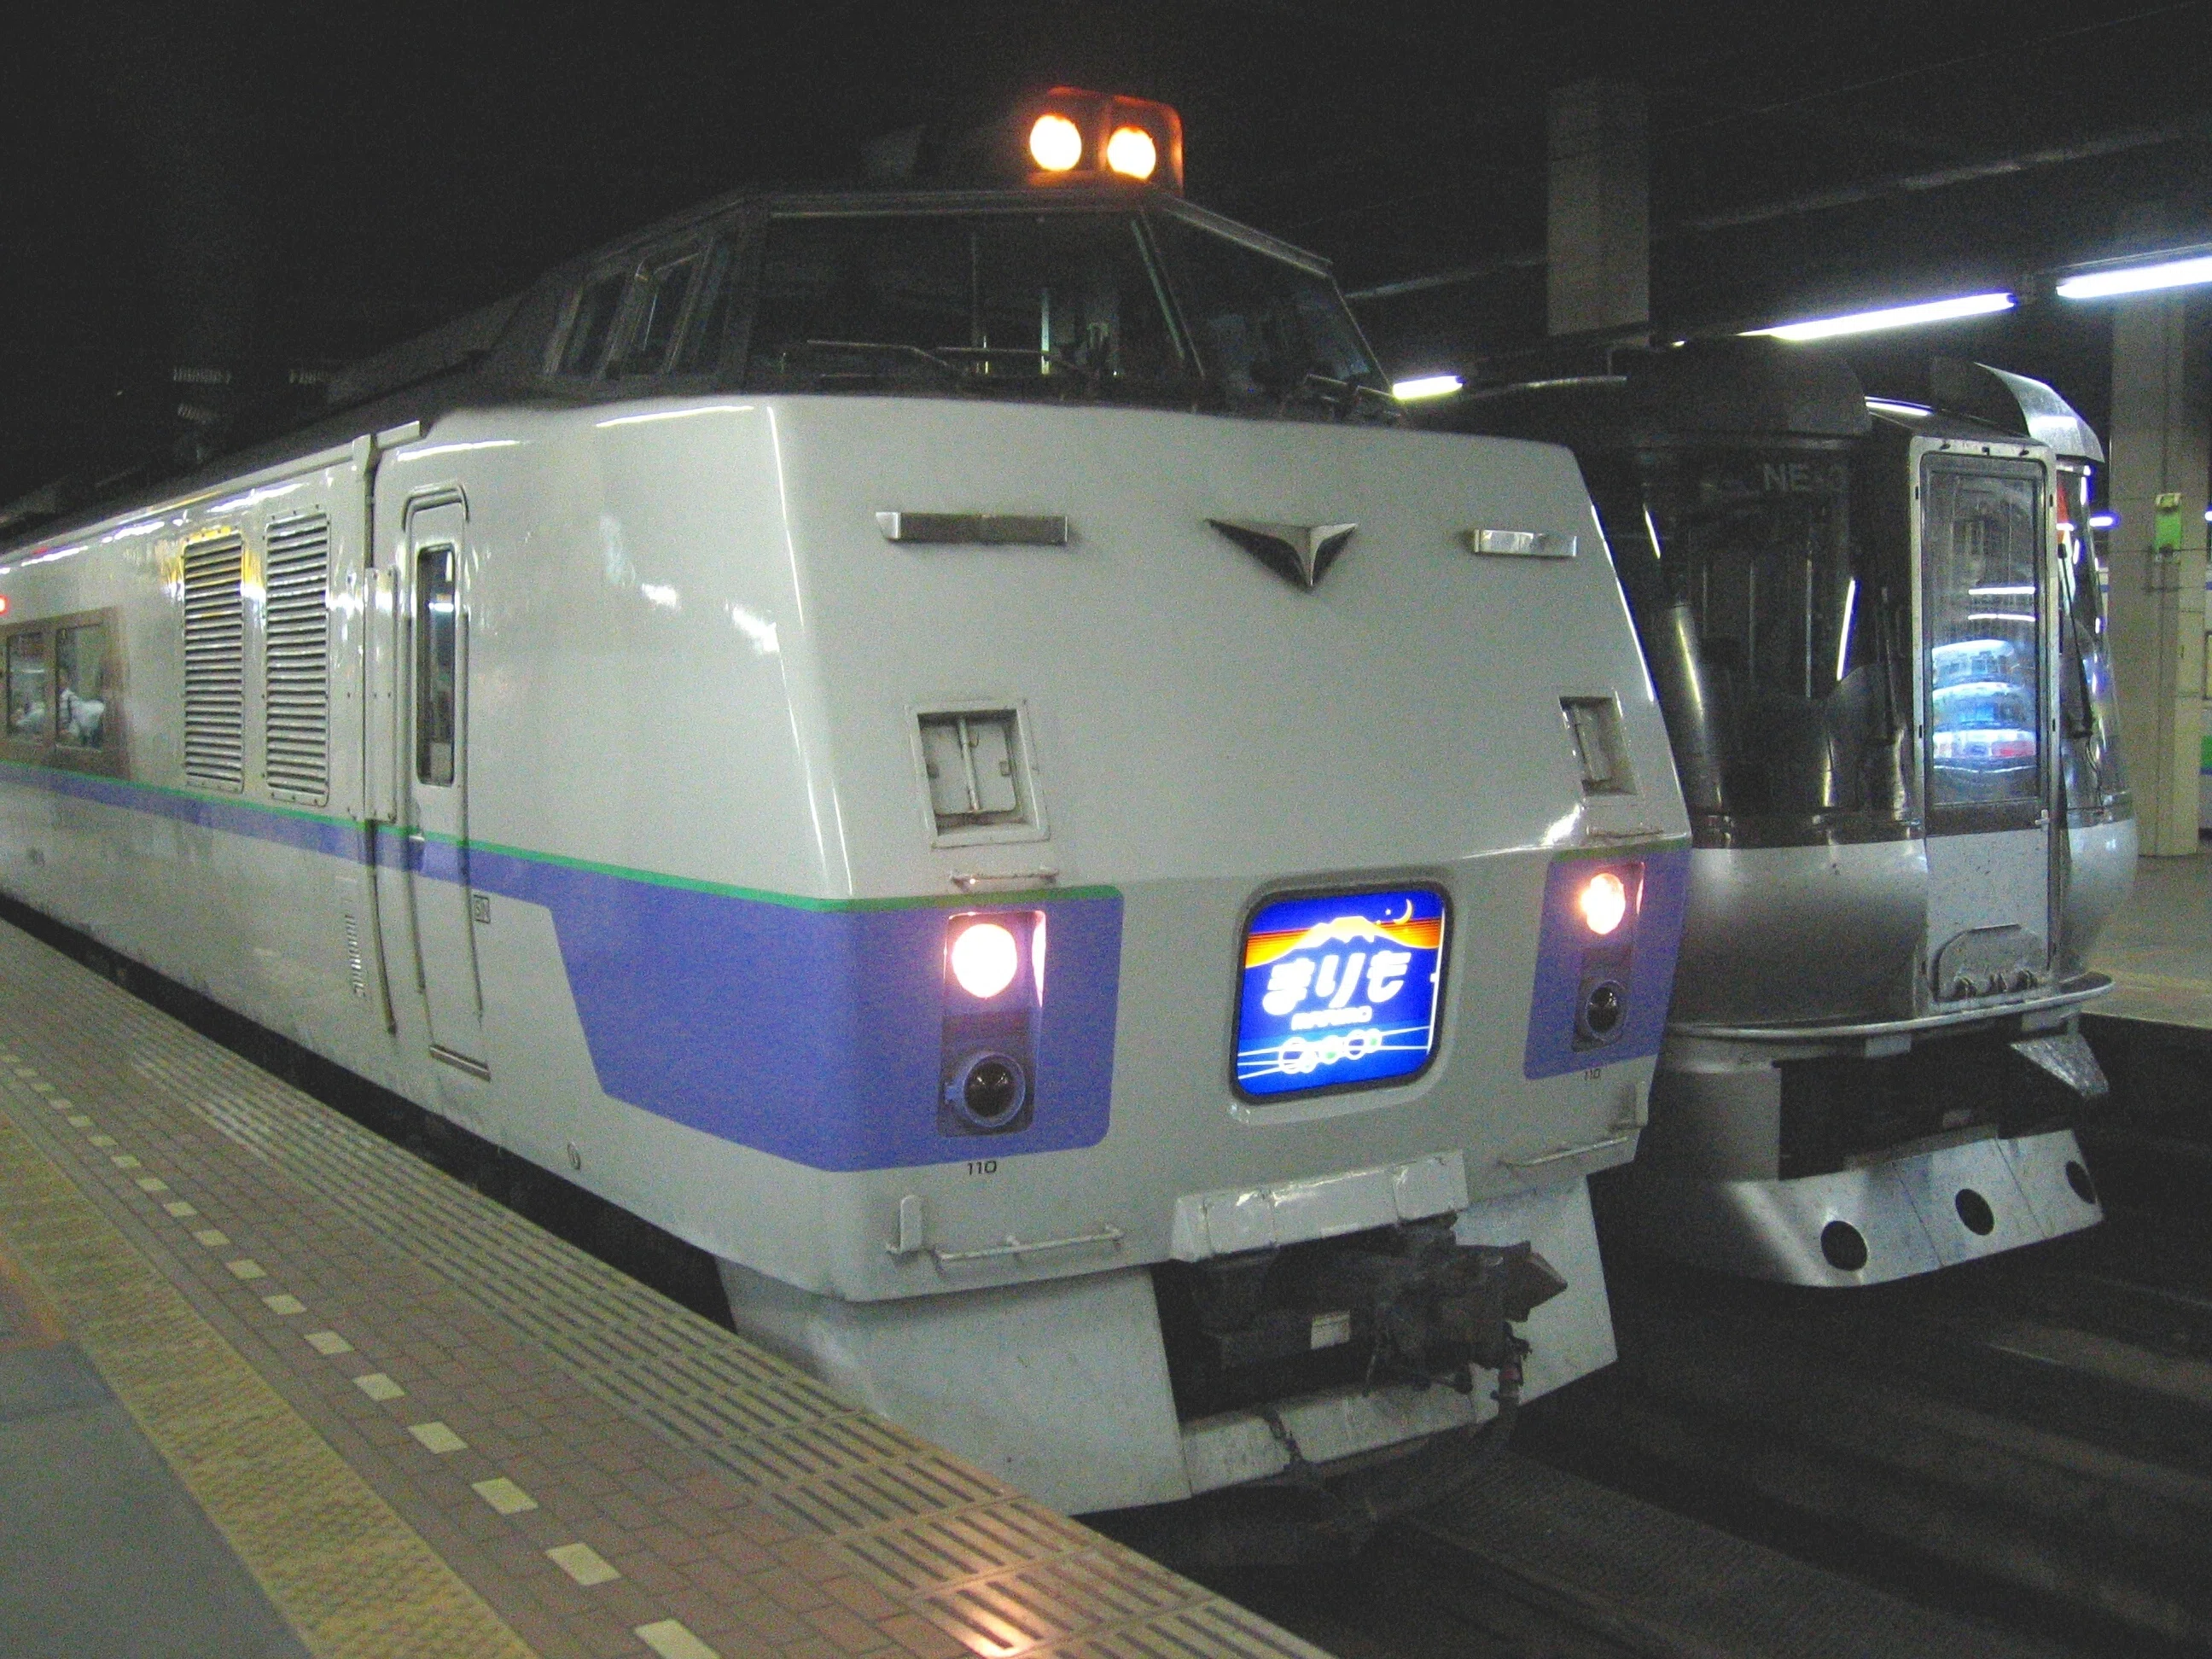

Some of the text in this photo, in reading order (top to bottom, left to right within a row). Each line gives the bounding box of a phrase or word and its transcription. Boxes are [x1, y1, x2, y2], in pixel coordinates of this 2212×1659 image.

[1262, 950, 1412, 1016] まりも
[967, 1161, 998, 1175] 110
